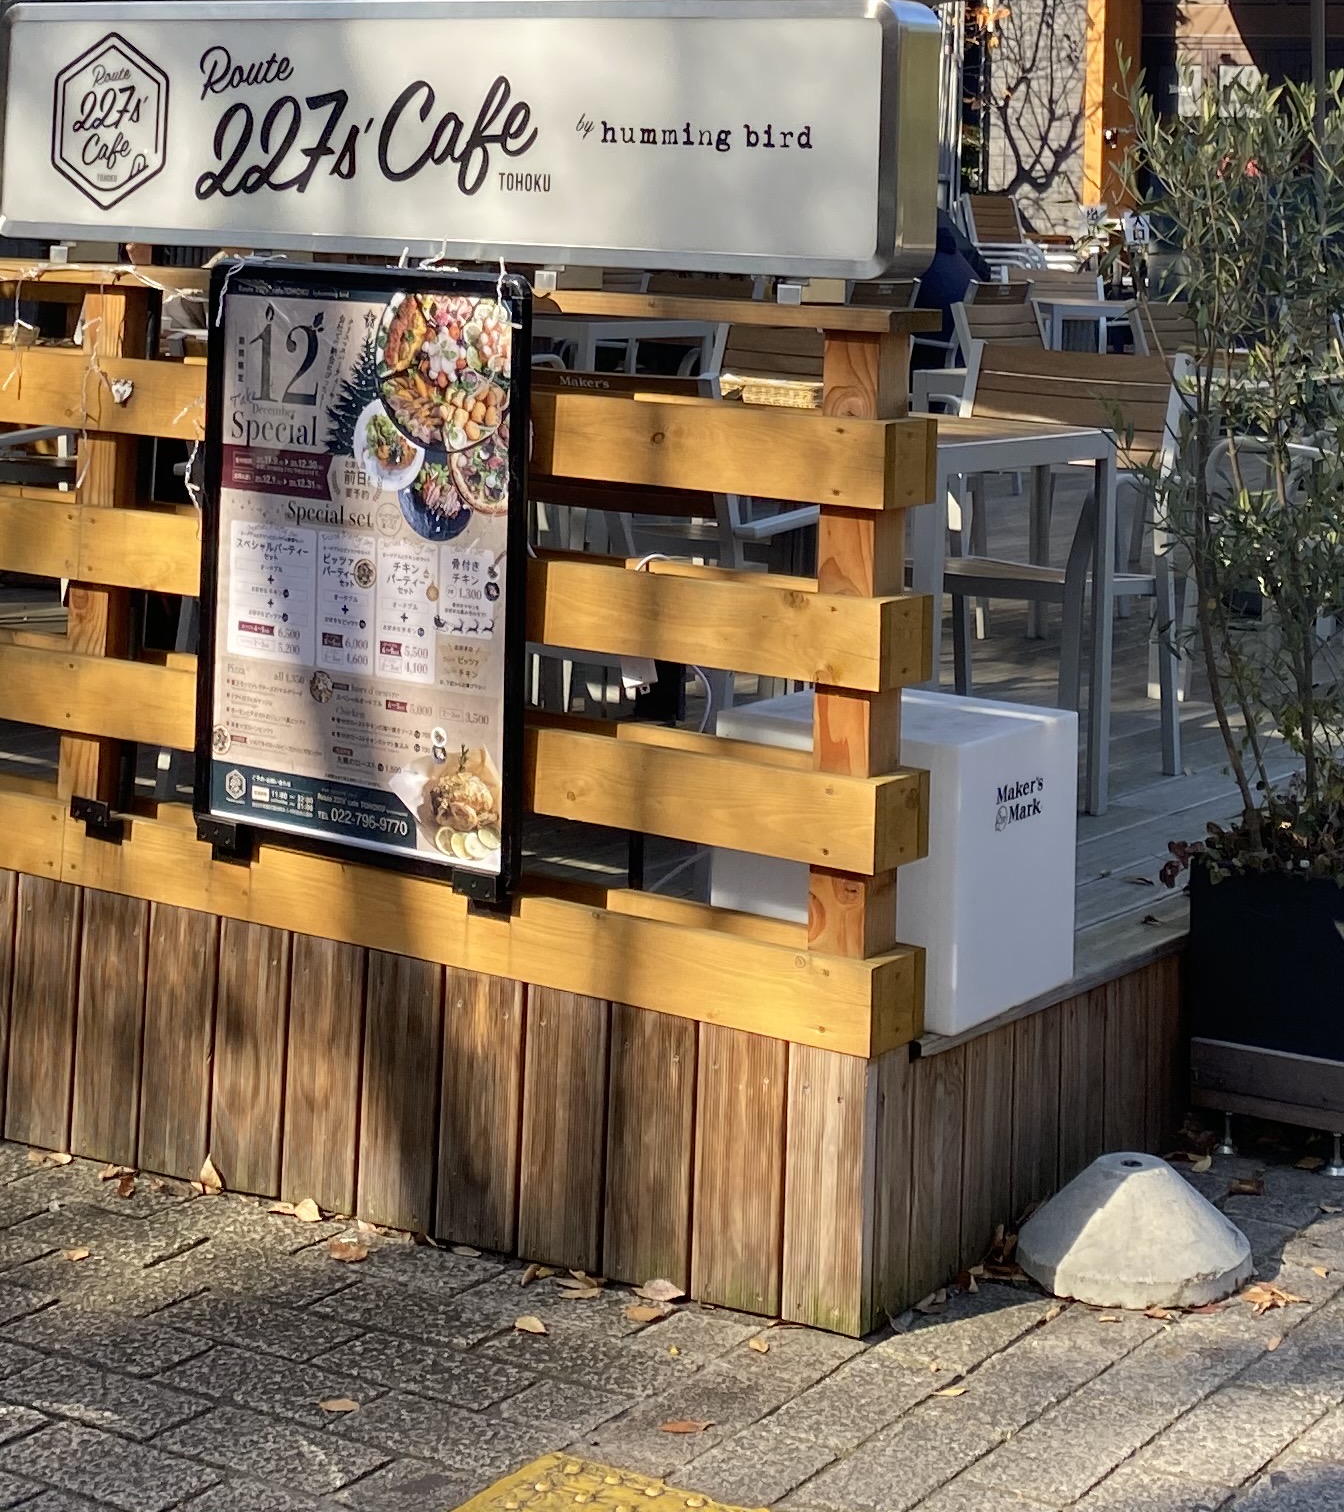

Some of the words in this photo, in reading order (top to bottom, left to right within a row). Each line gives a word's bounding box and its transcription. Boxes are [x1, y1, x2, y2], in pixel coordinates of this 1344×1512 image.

[92, 64, 132, 88] Route
[200, 44, 294, 101] Route
[378, 75, 539, 197] Cafe
[576, 112, 595, 139] by
[601, 120, 732, 154] humming
[745, 121, 814, 150] bird
[82, 132, 132, 170] Cafe
[498, 172, 552, 193] TOHOKU
[248, 324, 320, 405] 12
[252, 404, 297, 417] December
[231, 411, 318, 447] Special
[286, 500, 344, 525] Special
[349, 512, 374, 528] set
[387, 574, 426, 588] パーティー
[393, 562, 420, 575] チキン
[452, 574, 479, 586] チキン
[404, 645, 429, 659] 5,500
[465, 712, 490, 726] 3,500
[995, 776, 1044, 805] Maker's
[330, 807, 408, 836] 022-796-9770
[1008, 798, 1042, 824] Mark
